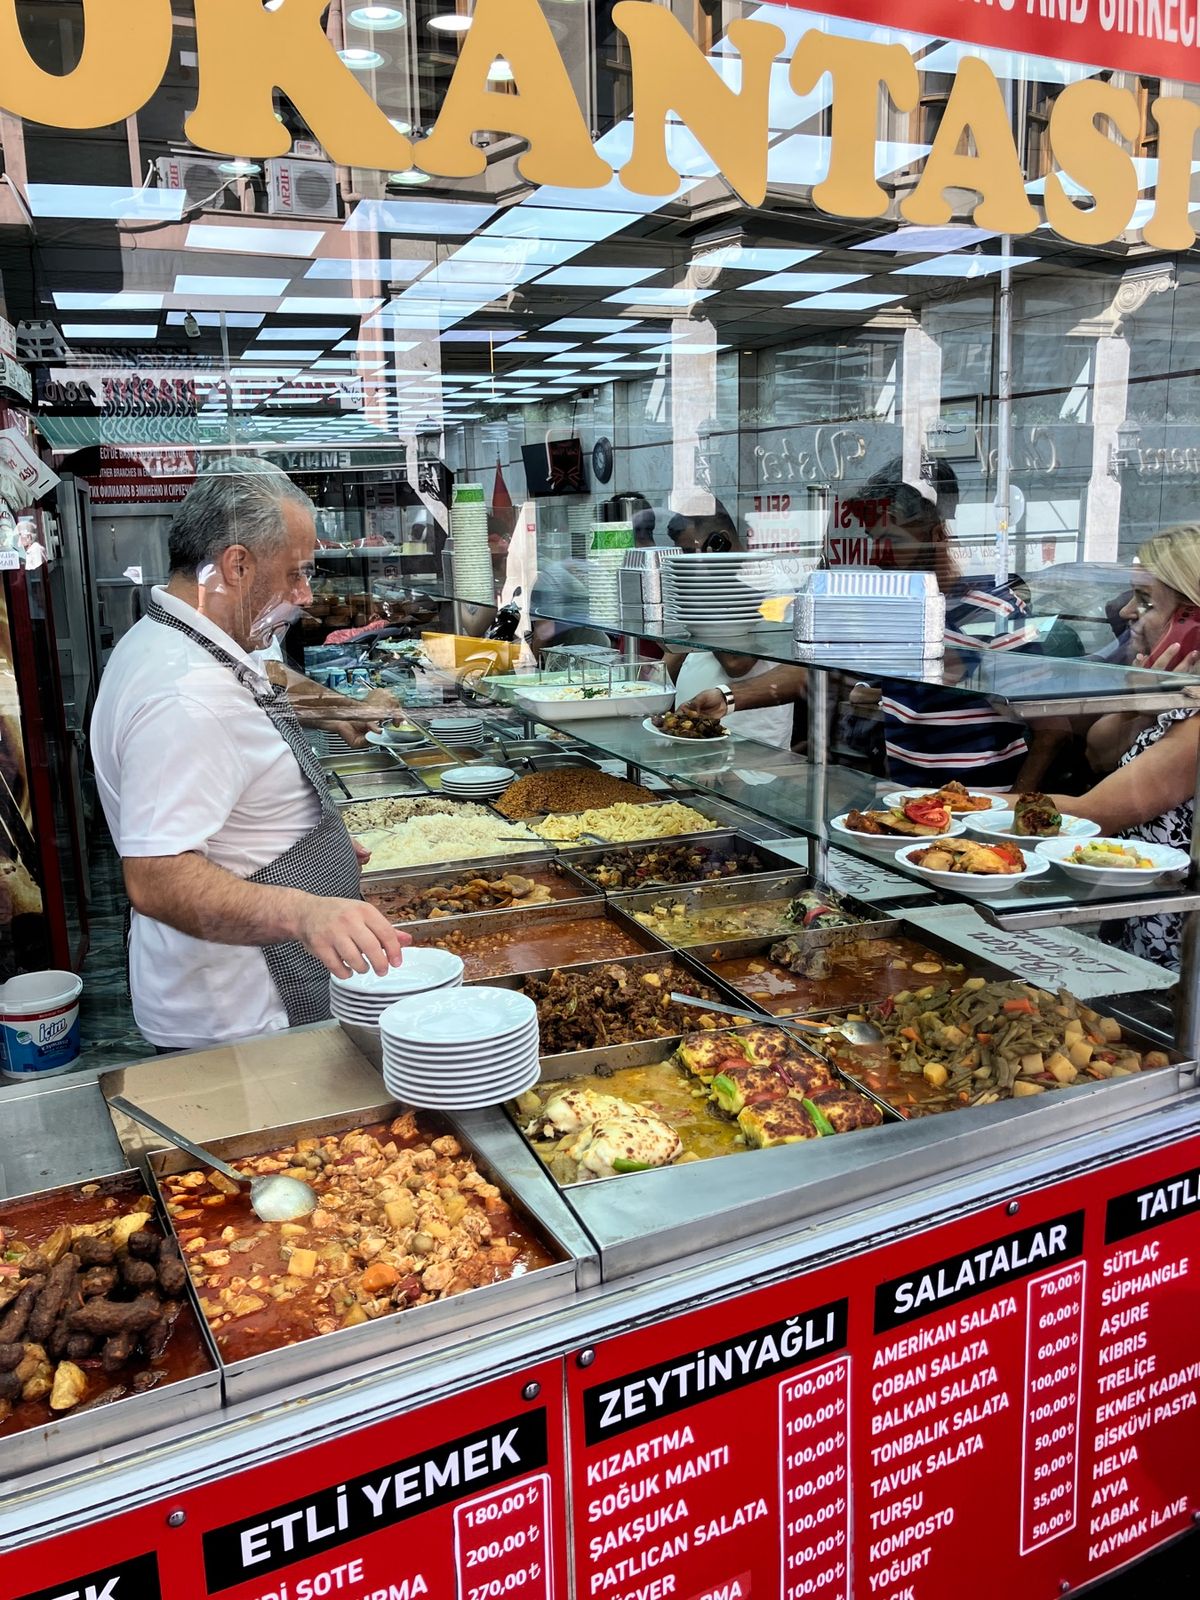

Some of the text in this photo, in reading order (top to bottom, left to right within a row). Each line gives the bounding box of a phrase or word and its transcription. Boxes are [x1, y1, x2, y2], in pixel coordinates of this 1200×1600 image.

[39, 1018, 66, 1042] İçim
[894, 1225, 1068, 1314] SALATALAR
[1102, 1258, 1189, 1307] SÜPHANGLE
[1103, 1241, 1160, 1277] SÜTLAÇ
[873, 1297, 1017, 1370] AMERİKAN SALATA
[1099, 1332, 1147, 1366] KIBRIS
[1100, 1302, 1150, 1338] AŞURE
[599, 1312, 835, 1429] ZEYTİNYAĞLI
[872, 1340, 989, 1406] ÇOBAN SALATA
[1098, 1355, 1156, 1394] TRELİÇE
[871, 1392, 1010, 1467] TONBALIK SALATA
[872, 1367, 998, 1436] BALKAN SALATA
[1095, 1391, 1198, 1452] BİSKÜVİ PASTA
[1096, 1387, 1146, 1423] EKMEK
[587, 1426, 695, 1487] KIZARTMA
[589, 1445, 729, 1523] SOĞUK MANTI
[871, 1434, 984, 1499] TAVUK SALATA
[1093, 1446, 1138, 1480] HELVA
[241, 1428, 521, 1568] ETLİ YEMEK
[870, 1492, 923, 1530] TURŞU
[1091, 1497, 1139, 1535] KABAK
[1092, 1478, 1129, 1508] AYVA
[590, 1499, 689, 1563] ŞAKŞUKA
[591, 1499, 768, 1595] PATLICAN SALATA
[870, 1508, 954, 1563] KOMPOSTO
[1089, 1497, 1188, 1562] KAYMAK İLAVE
[296, 1558, 364, 1600] SOTE
[869, 1547, 932, 1592] YOĞURT
